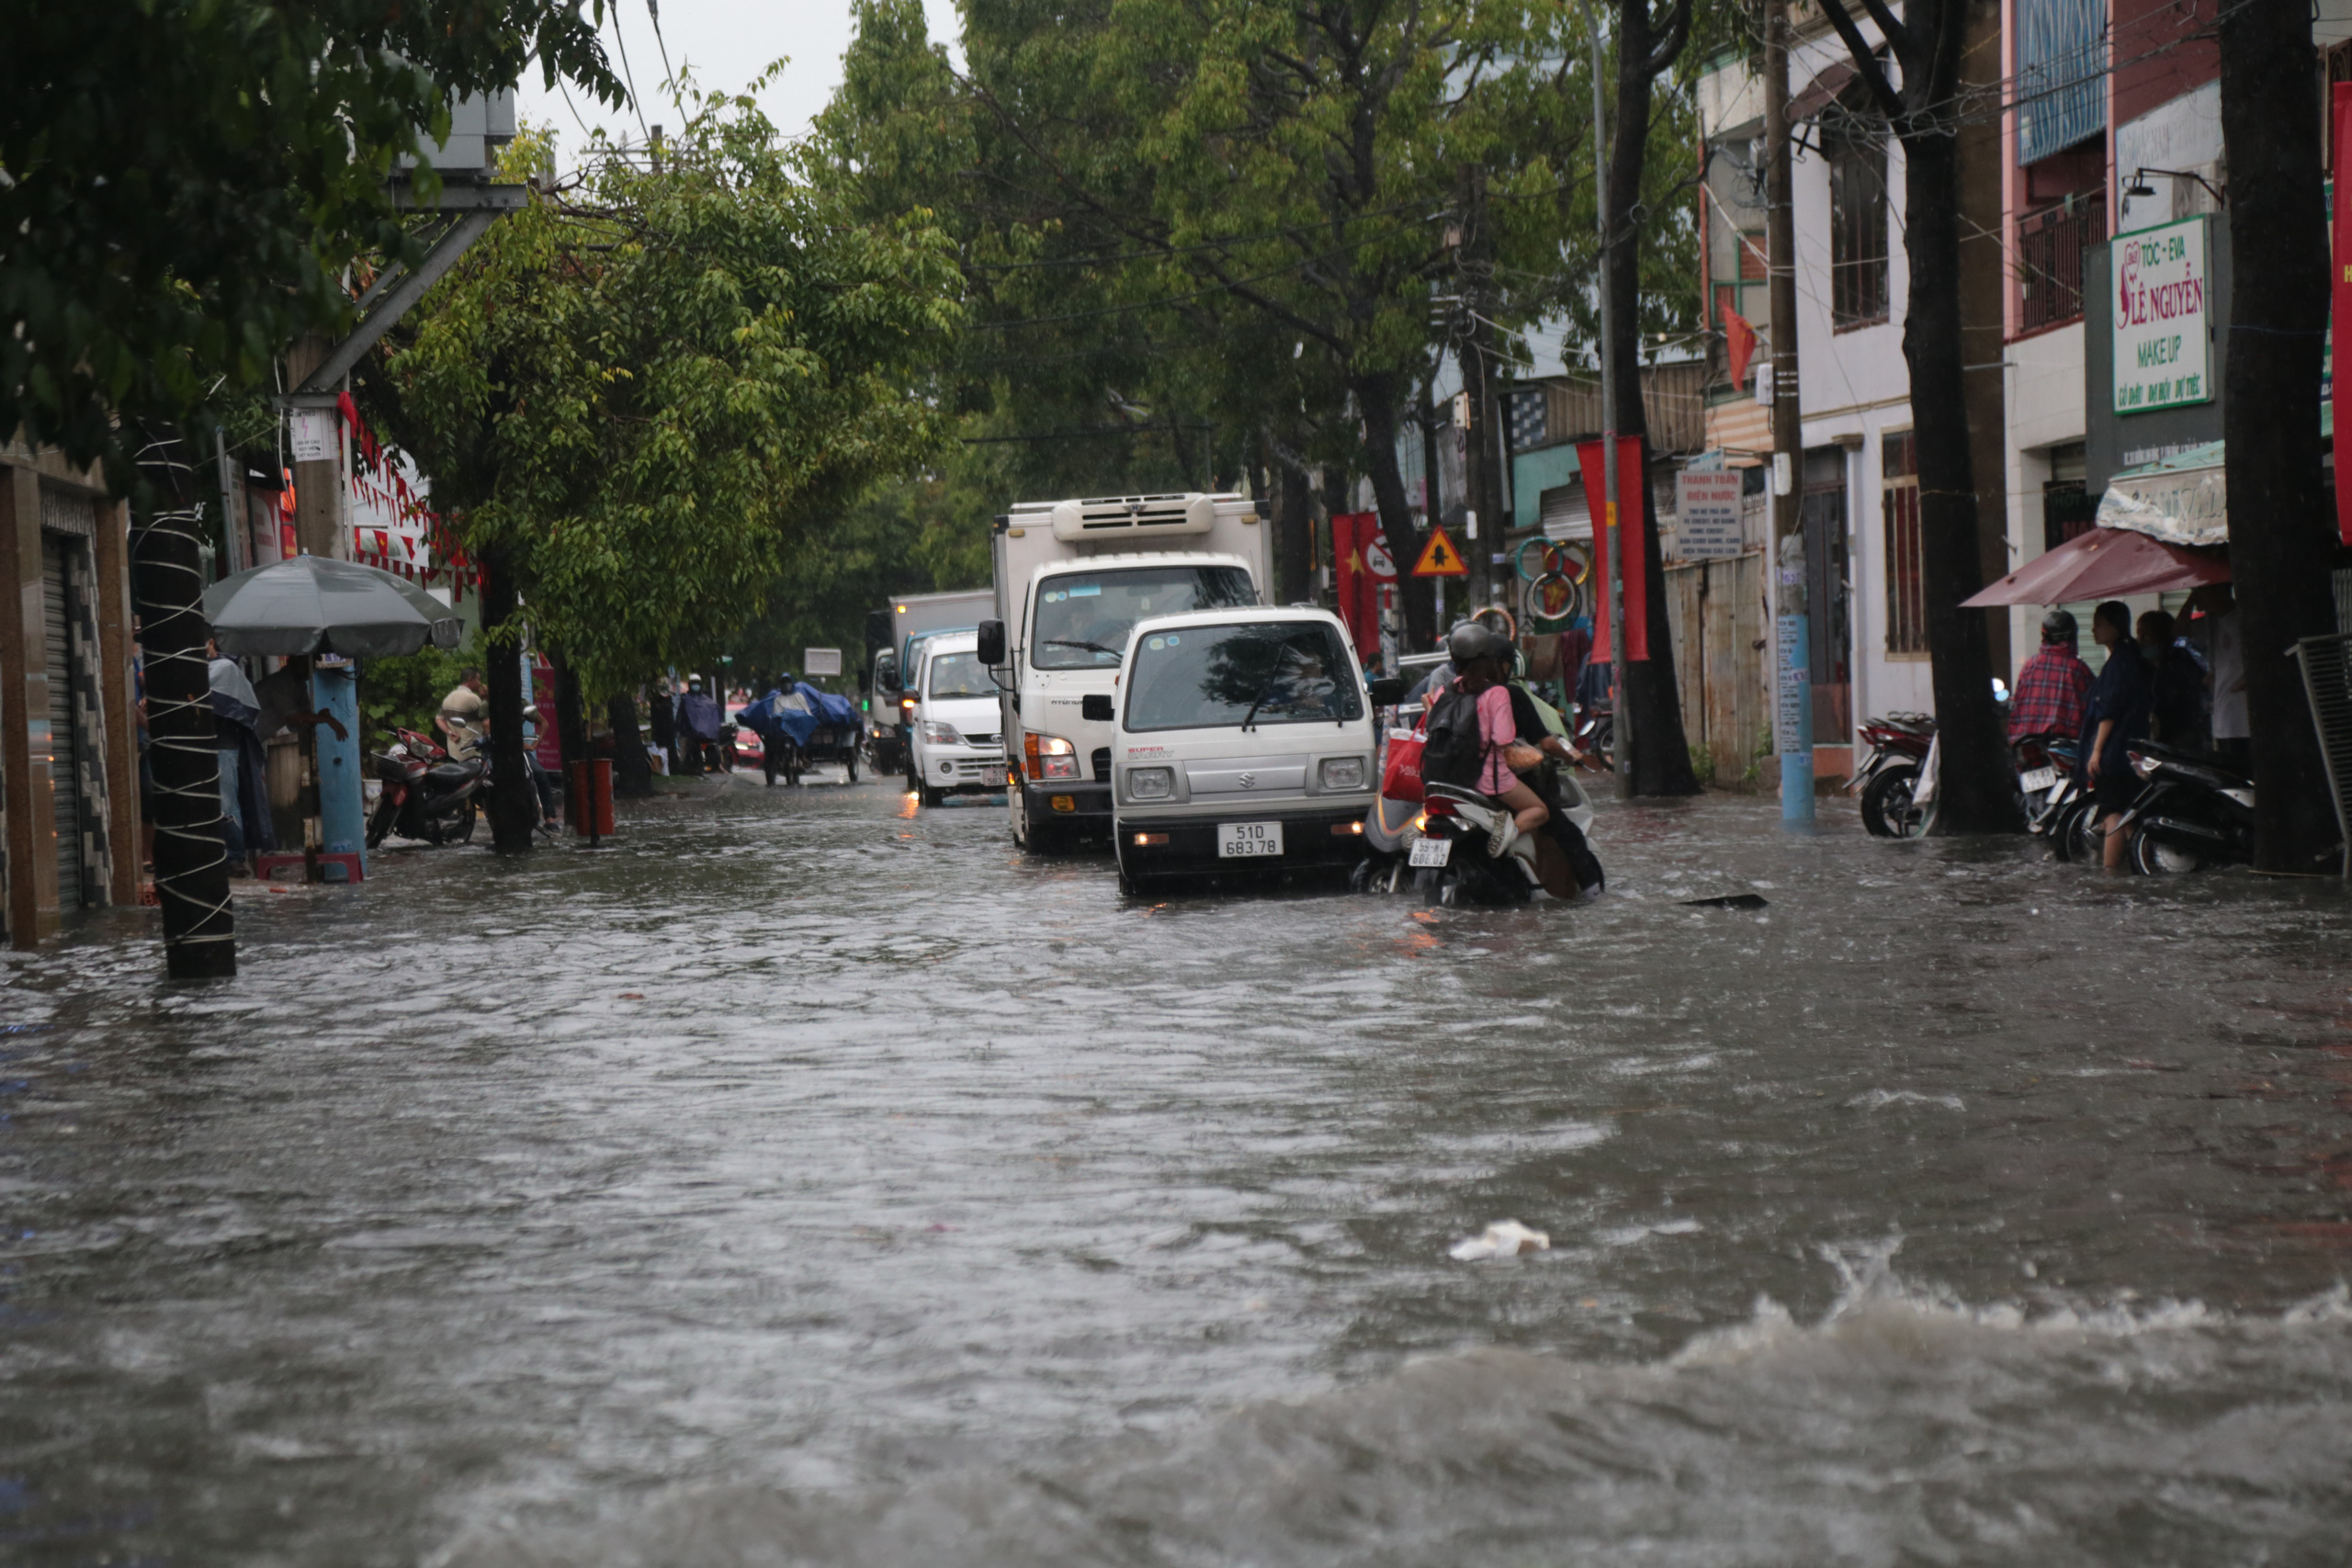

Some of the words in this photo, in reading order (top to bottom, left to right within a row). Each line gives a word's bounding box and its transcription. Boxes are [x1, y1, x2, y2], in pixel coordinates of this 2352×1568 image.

[2141, 236, 2161, 268] TÓC
[2169, 235, 2186, 262] EVA
[2131, 281, 2147, 325] LÊ
[2150, 261, 2203, 322] NGUYỄN
[2137, 338, 2166, 368] MAKE
[2168, 334, 2182, 364] UP
[1682, 475, 1712, 485] THANH
[1714, 471, 1738, 485] TOÁN
[1687, 489, 1708, 502] ĐIỆN
[1127, 750, 1175, 760] CARRY
[1237, 826, 1264, 840] 51D
[1227, 840, 1276, 855] 683.78
